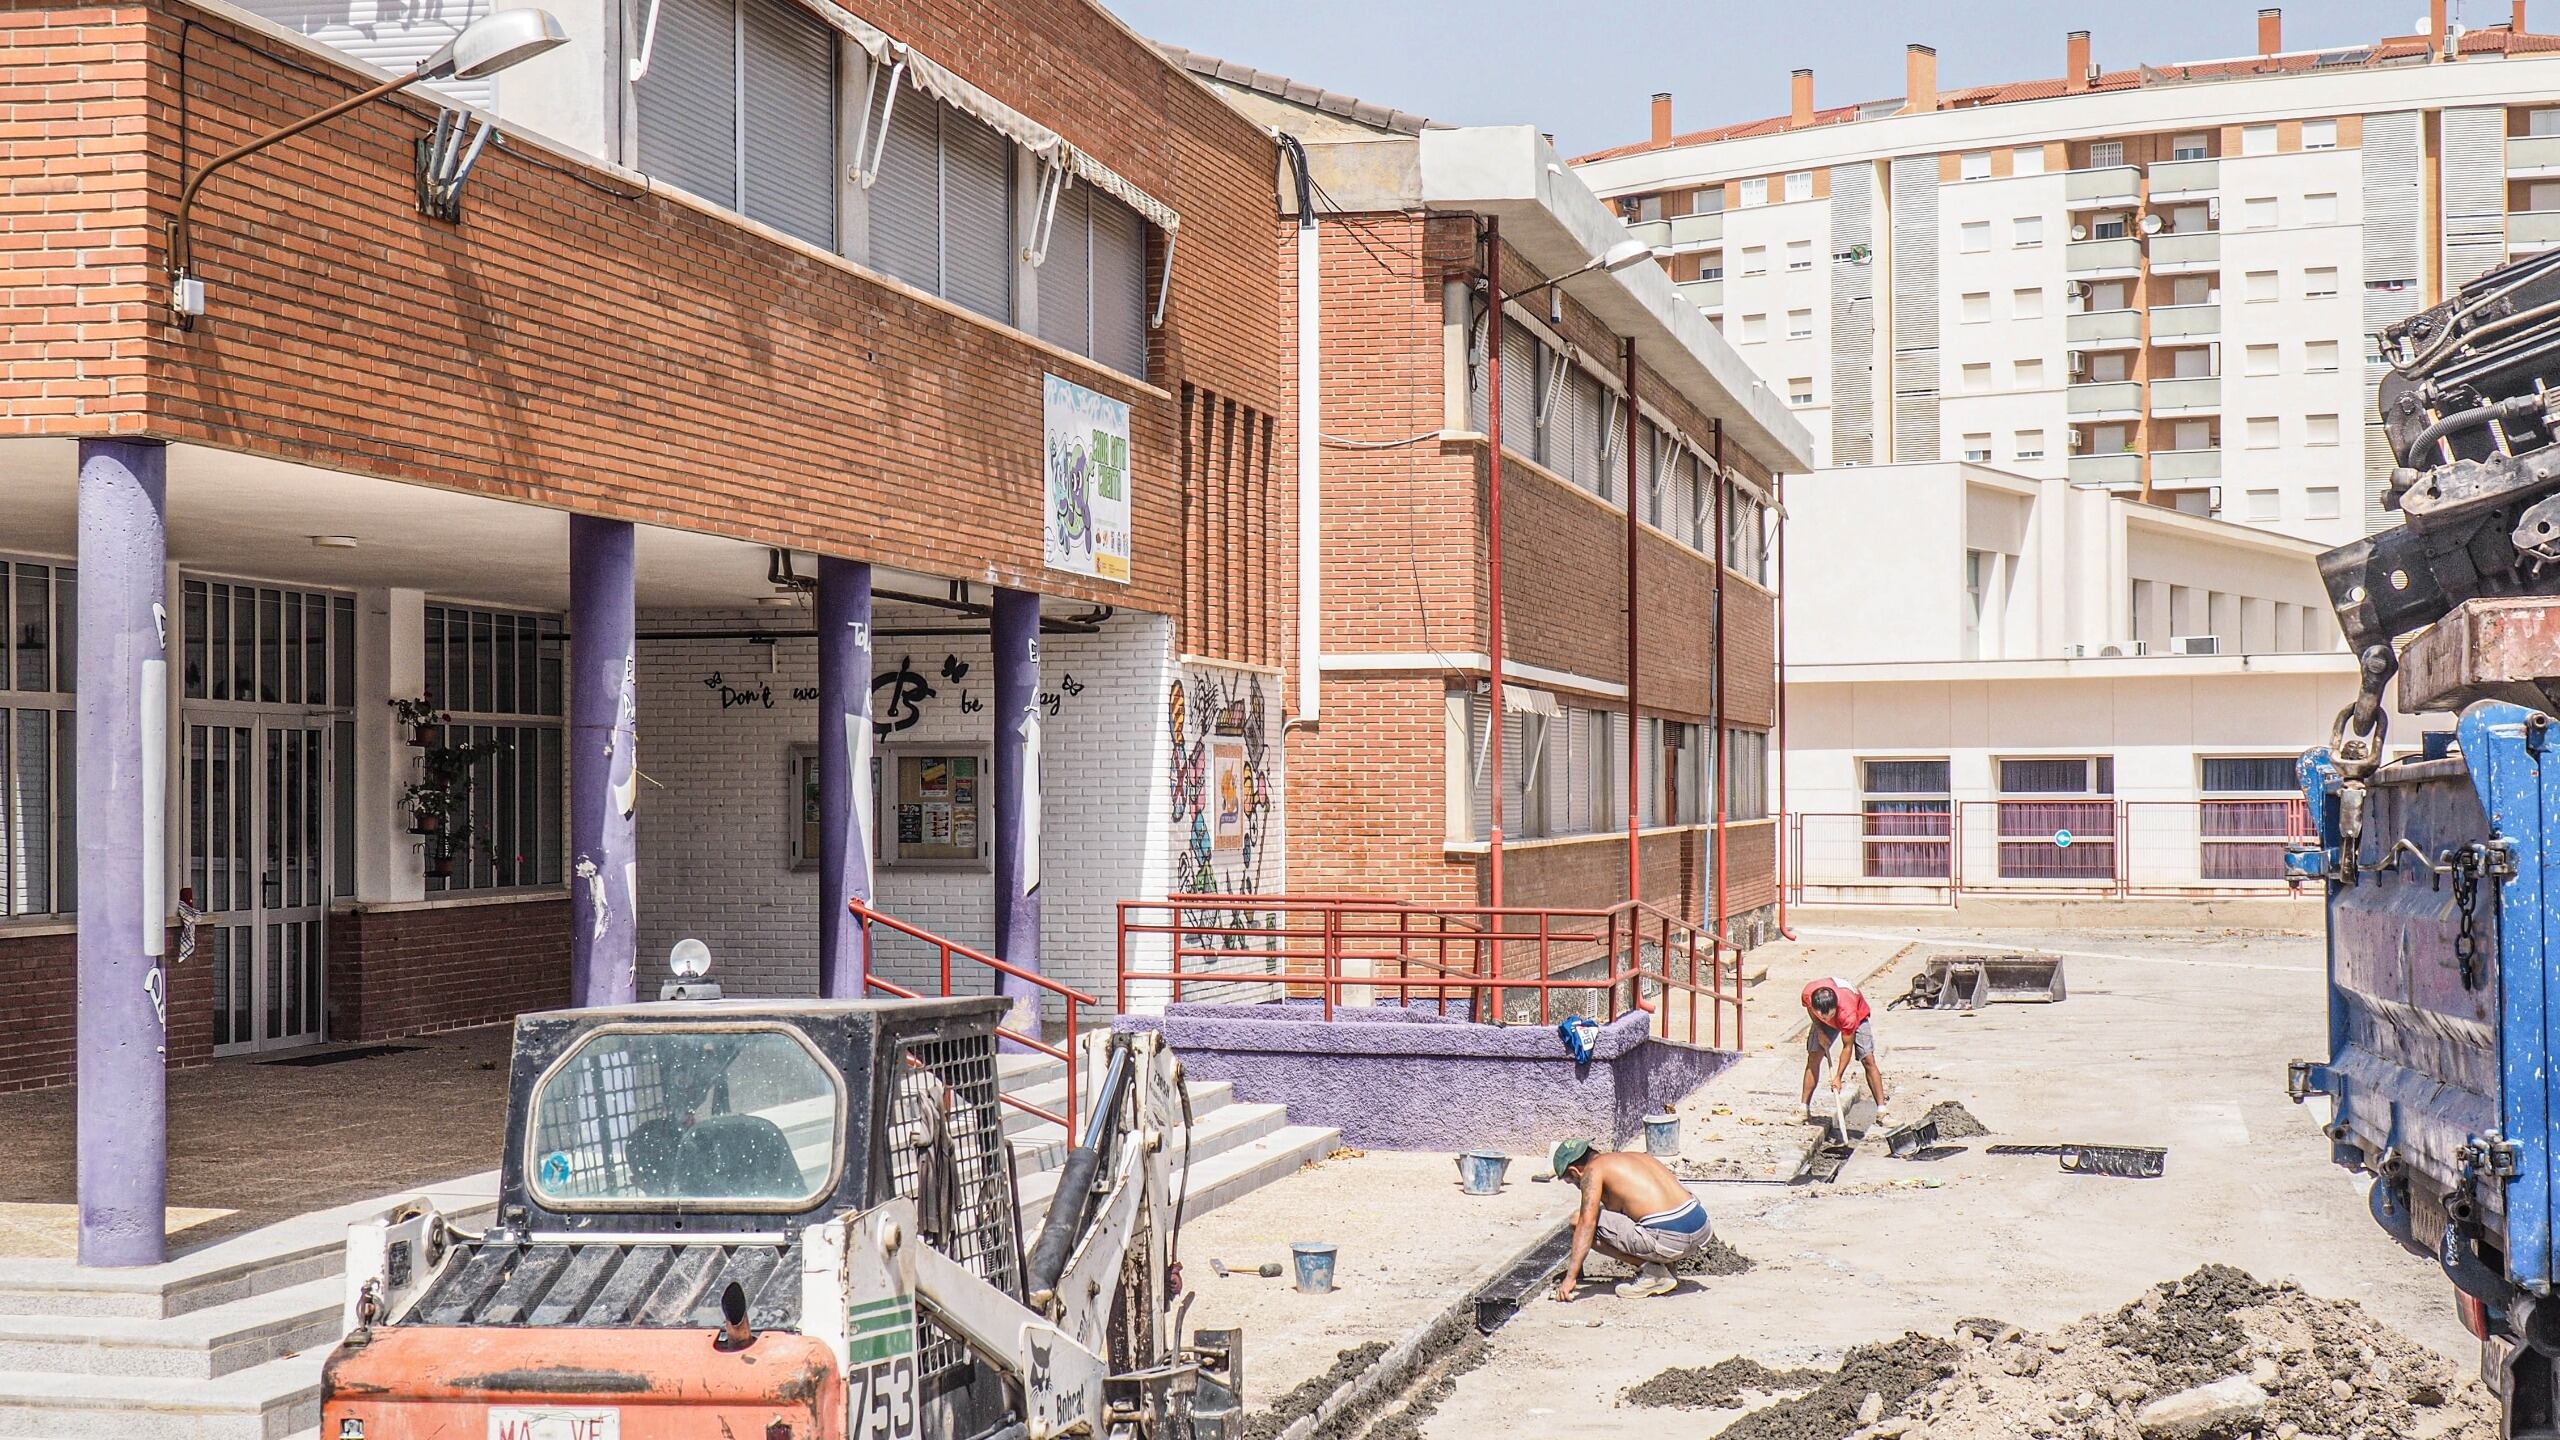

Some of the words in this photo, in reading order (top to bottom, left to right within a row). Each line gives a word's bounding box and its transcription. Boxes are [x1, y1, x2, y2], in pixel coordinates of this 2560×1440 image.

[719, 681, 774, 709] Don't
[793, 687, 819, 701] wo
[961, 688, 984, 714] be
[850, 1356, 914, 1440] 753
[1056, 1383, 1085, 1427] Bobcat
